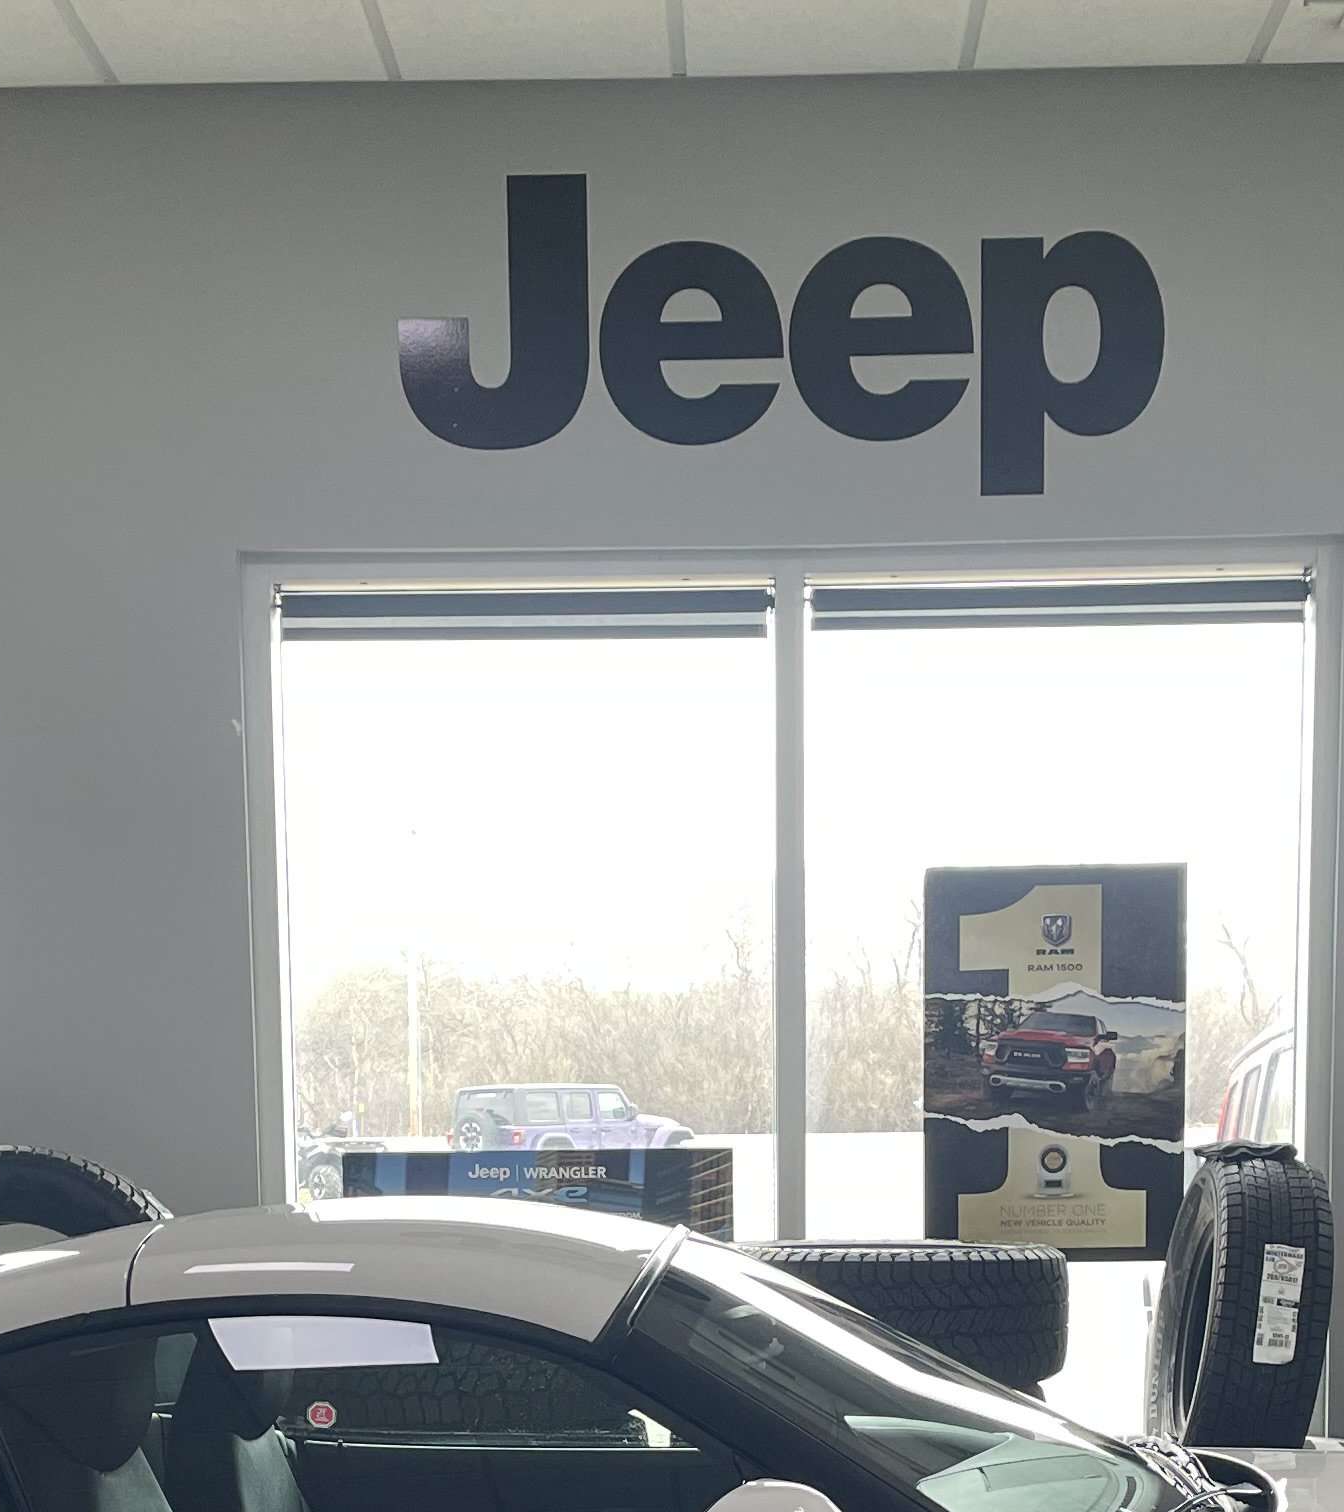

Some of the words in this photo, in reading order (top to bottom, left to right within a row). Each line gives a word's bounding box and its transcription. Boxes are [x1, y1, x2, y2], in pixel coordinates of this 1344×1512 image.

[396, 173, 1166, 497] Jeep
[1035, 948, 1075, 956] RAM
[1027, 963, 1054, 972] RAM
[1056, 963, 1084, 972] 1500
[467, 1164, 511, 1181] Jeep
[523, 1165, 607, 1180] WRANGLER
[999, 1203, 1066, 1218] NUMBER
[1071, 1203, 1106, 1217] ONE
[999, 1219, 1023, 1227] NEW
[1024, 1218, 1063, 1227] VEHICLE
[1065, 1218, 1107, 1227] QUALITY
